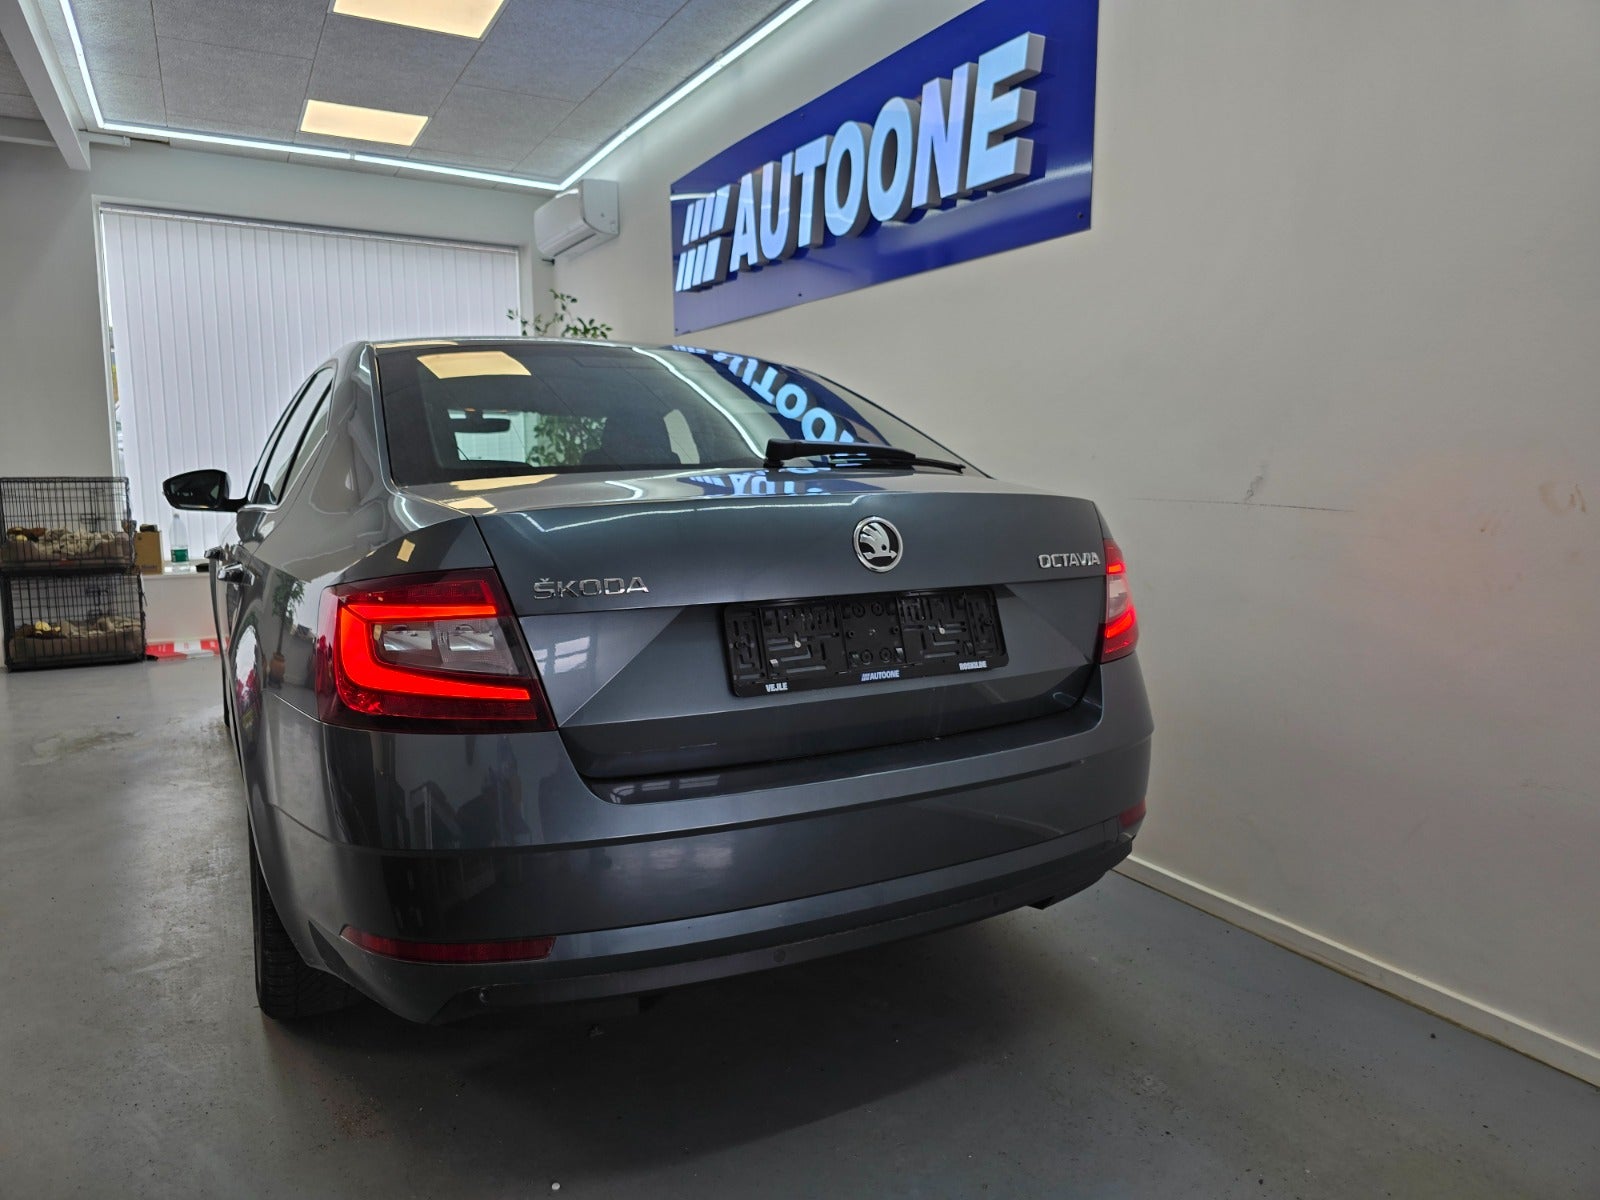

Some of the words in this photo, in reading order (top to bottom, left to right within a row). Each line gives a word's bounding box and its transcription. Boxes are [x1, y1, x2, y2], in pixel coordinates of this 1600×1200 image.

[729, 31, 1046, 273] AUTOONE
[1038, 551, 1101, 569] OCTAVIA
[533, 576, 650, 600] ŠKODA
[869, 670, 900, 681] AUTOONE
[765, 682, 789, 692] VEJLE
